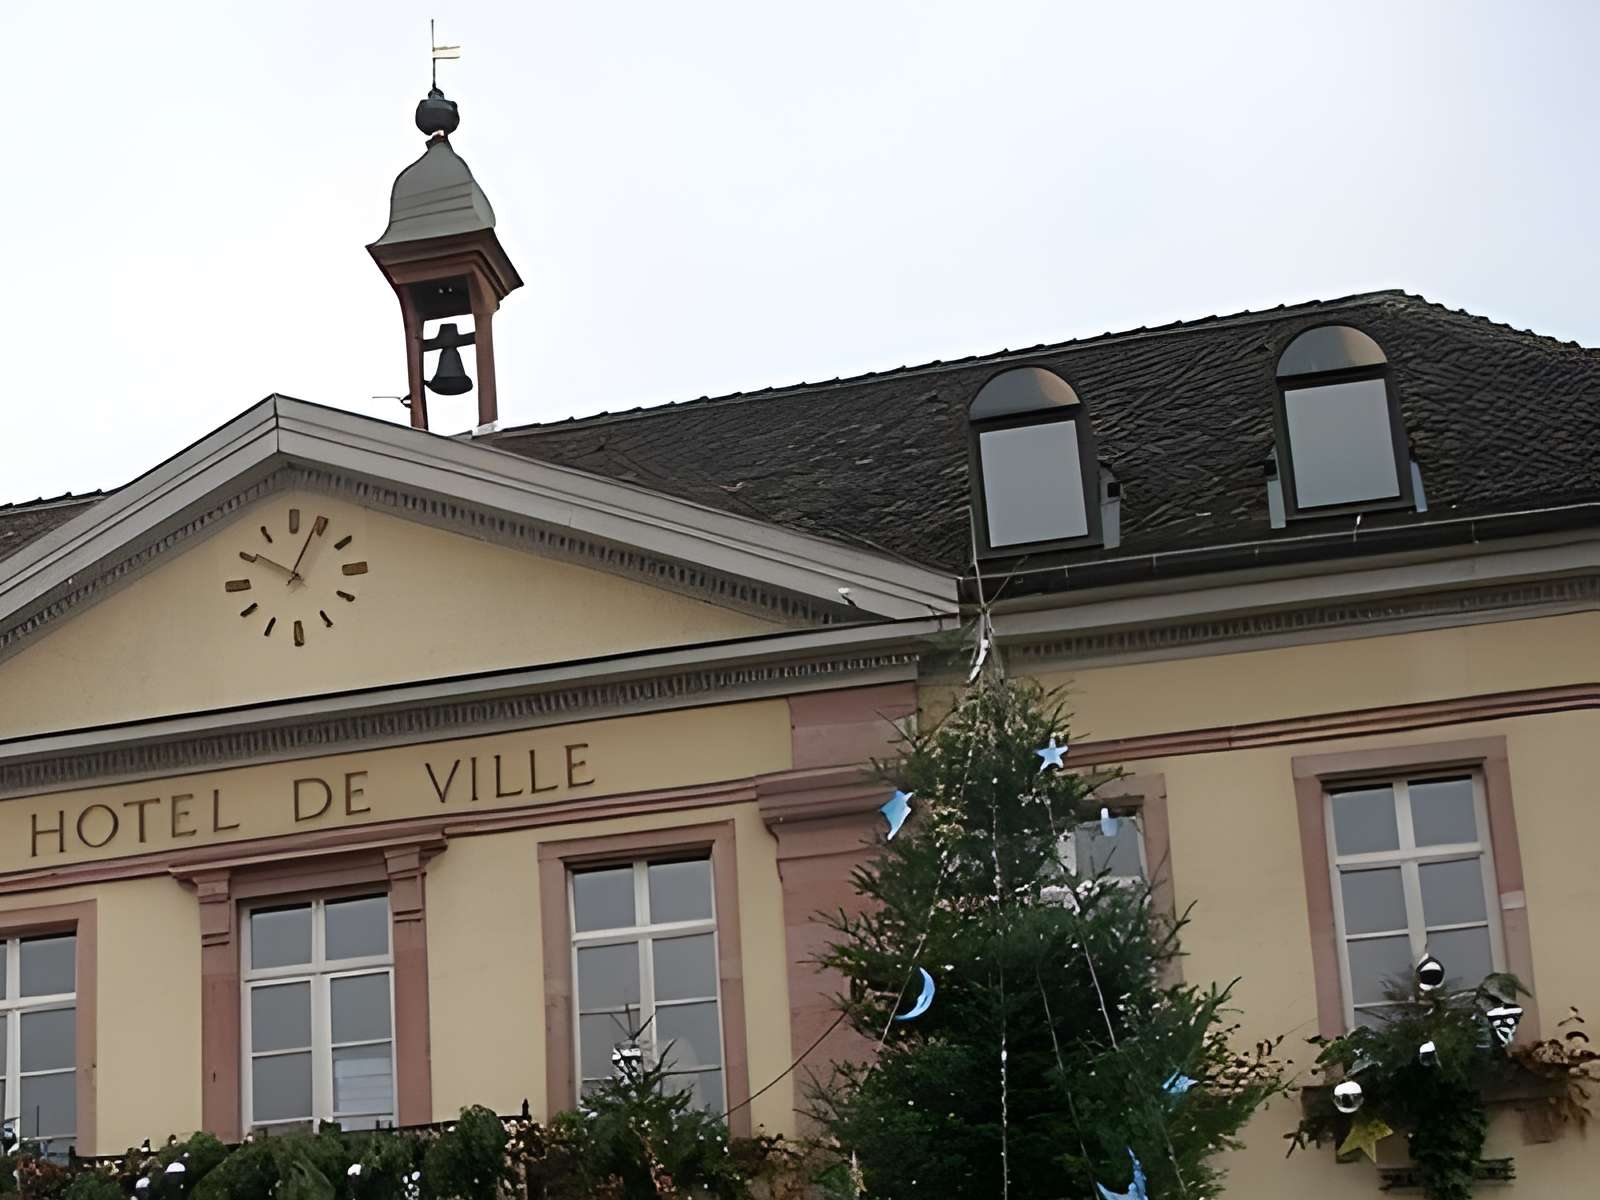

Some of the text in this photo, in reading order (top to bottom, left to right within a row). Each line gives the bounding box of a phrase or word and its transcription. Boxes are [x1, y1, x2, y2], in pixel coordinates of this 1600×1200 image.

[31, 743, 596, 857] HOTEL DE VILLE
